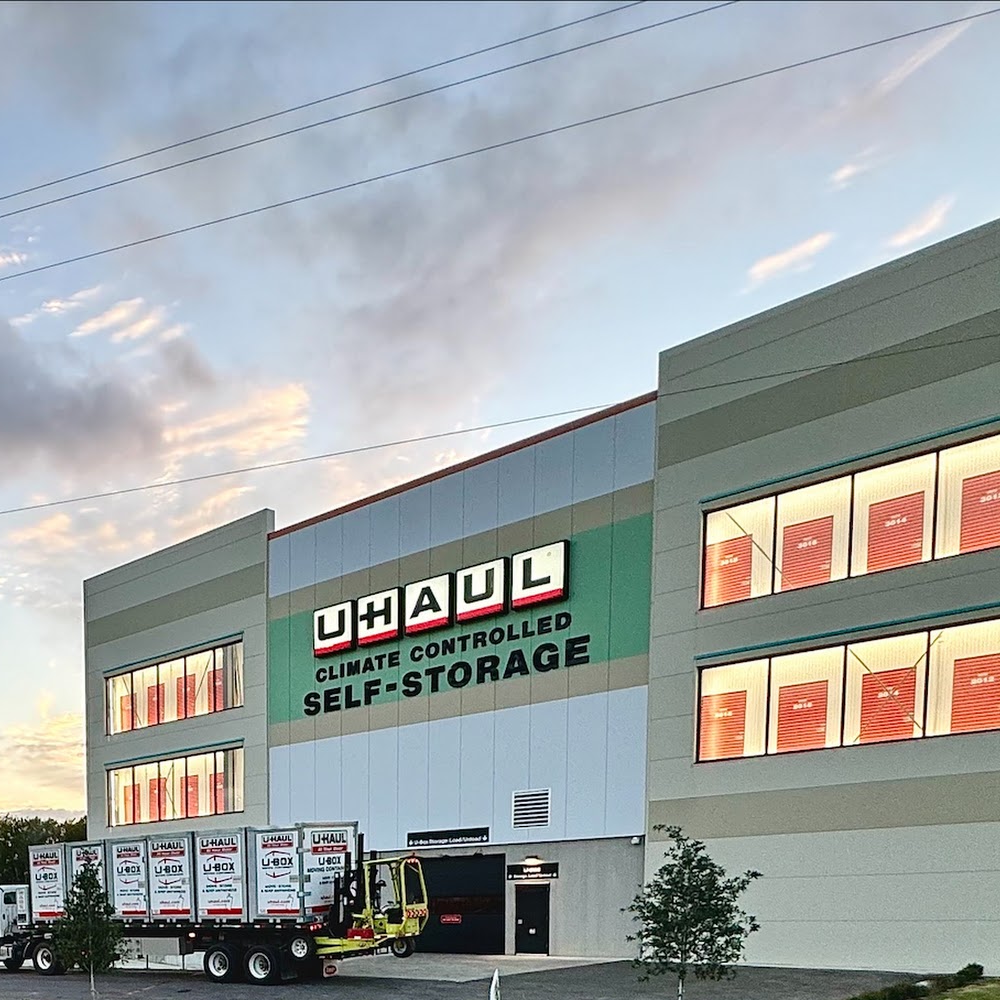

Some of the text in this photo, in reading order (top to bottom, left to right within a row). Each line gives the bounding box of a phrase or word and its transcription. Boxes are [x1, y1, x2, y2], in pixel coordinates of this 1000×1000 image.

[315, 612, 572, 683] CLIMATE CONTROLLED
[303, 634, 591, 716] SELF-STORAGE
[203, 862, 235, 872] U-BOX
[261, 857, 294, 867] U-BOX
[154, 864, 184, 874] U-BOX
